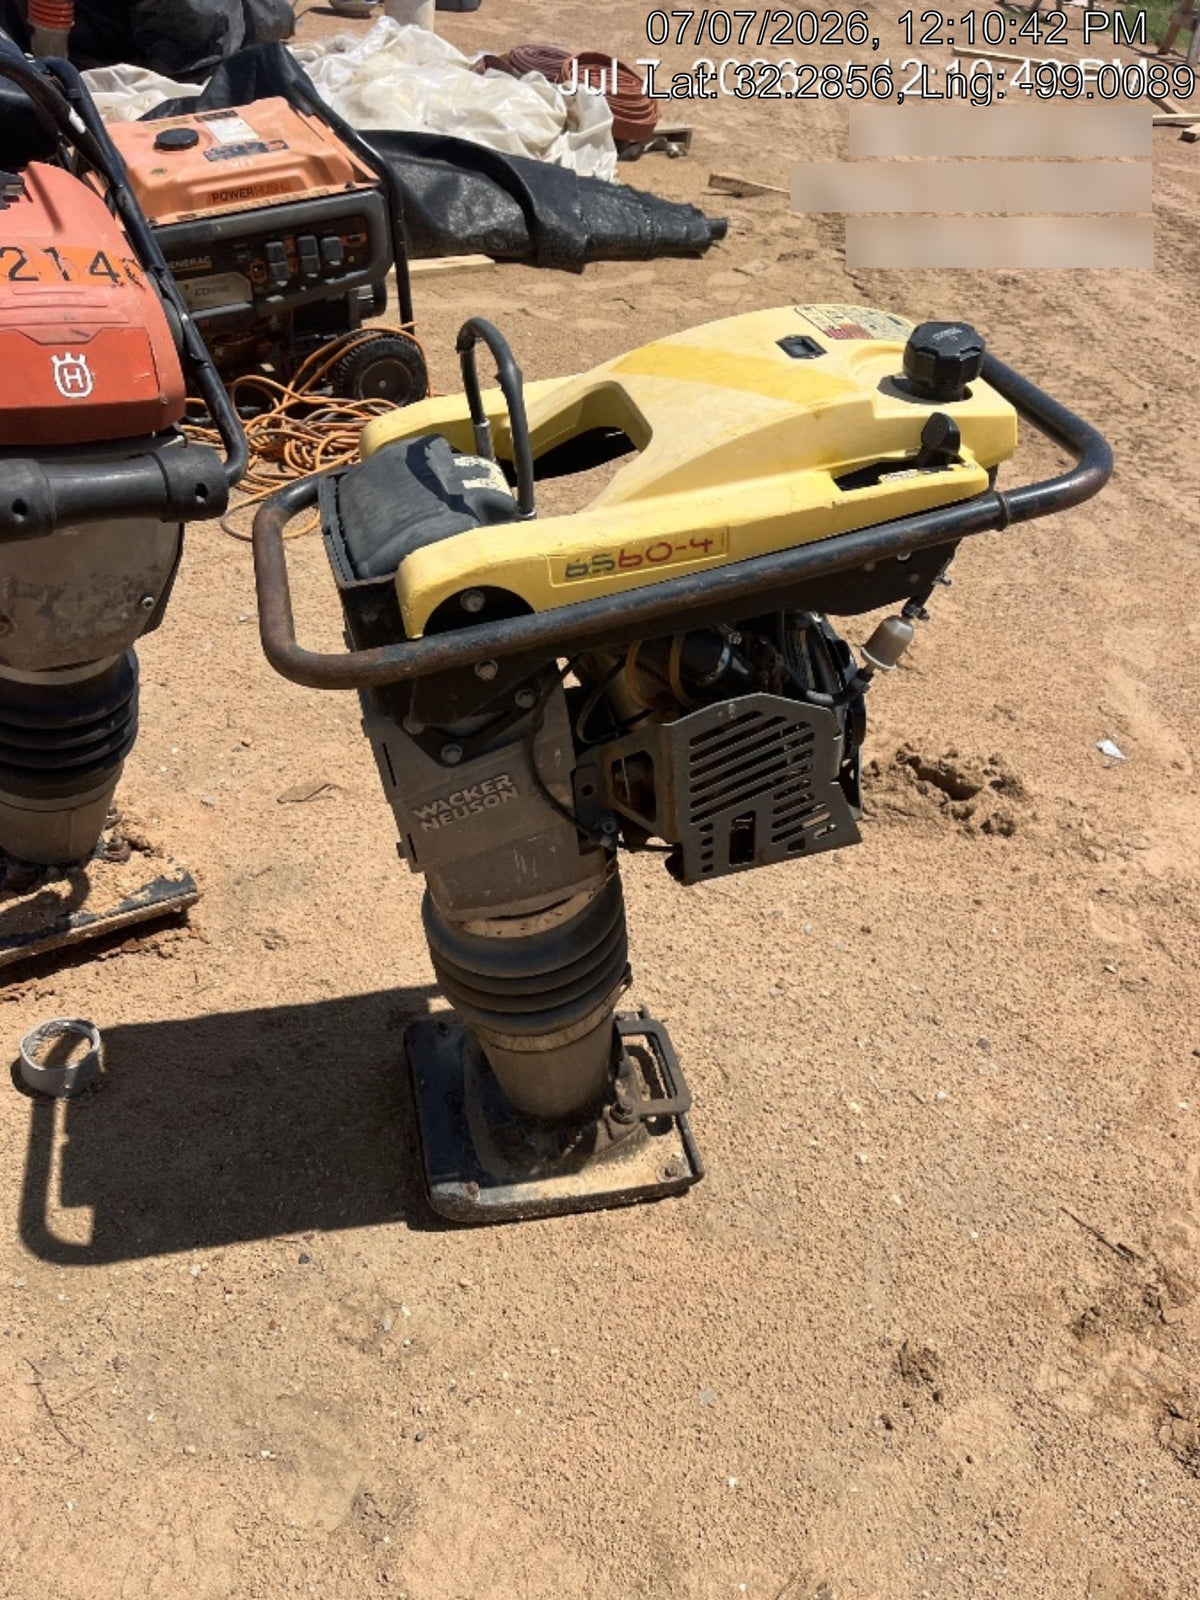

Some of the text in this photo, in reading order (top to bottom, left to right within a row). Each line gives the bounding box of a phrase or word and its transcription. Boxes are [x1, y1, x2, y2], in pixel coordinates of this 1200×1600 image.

[63, 367, 85, 389] H
[411, 773, 513, 820] WACKER
[421, 786, 519, 832] NEUSON
